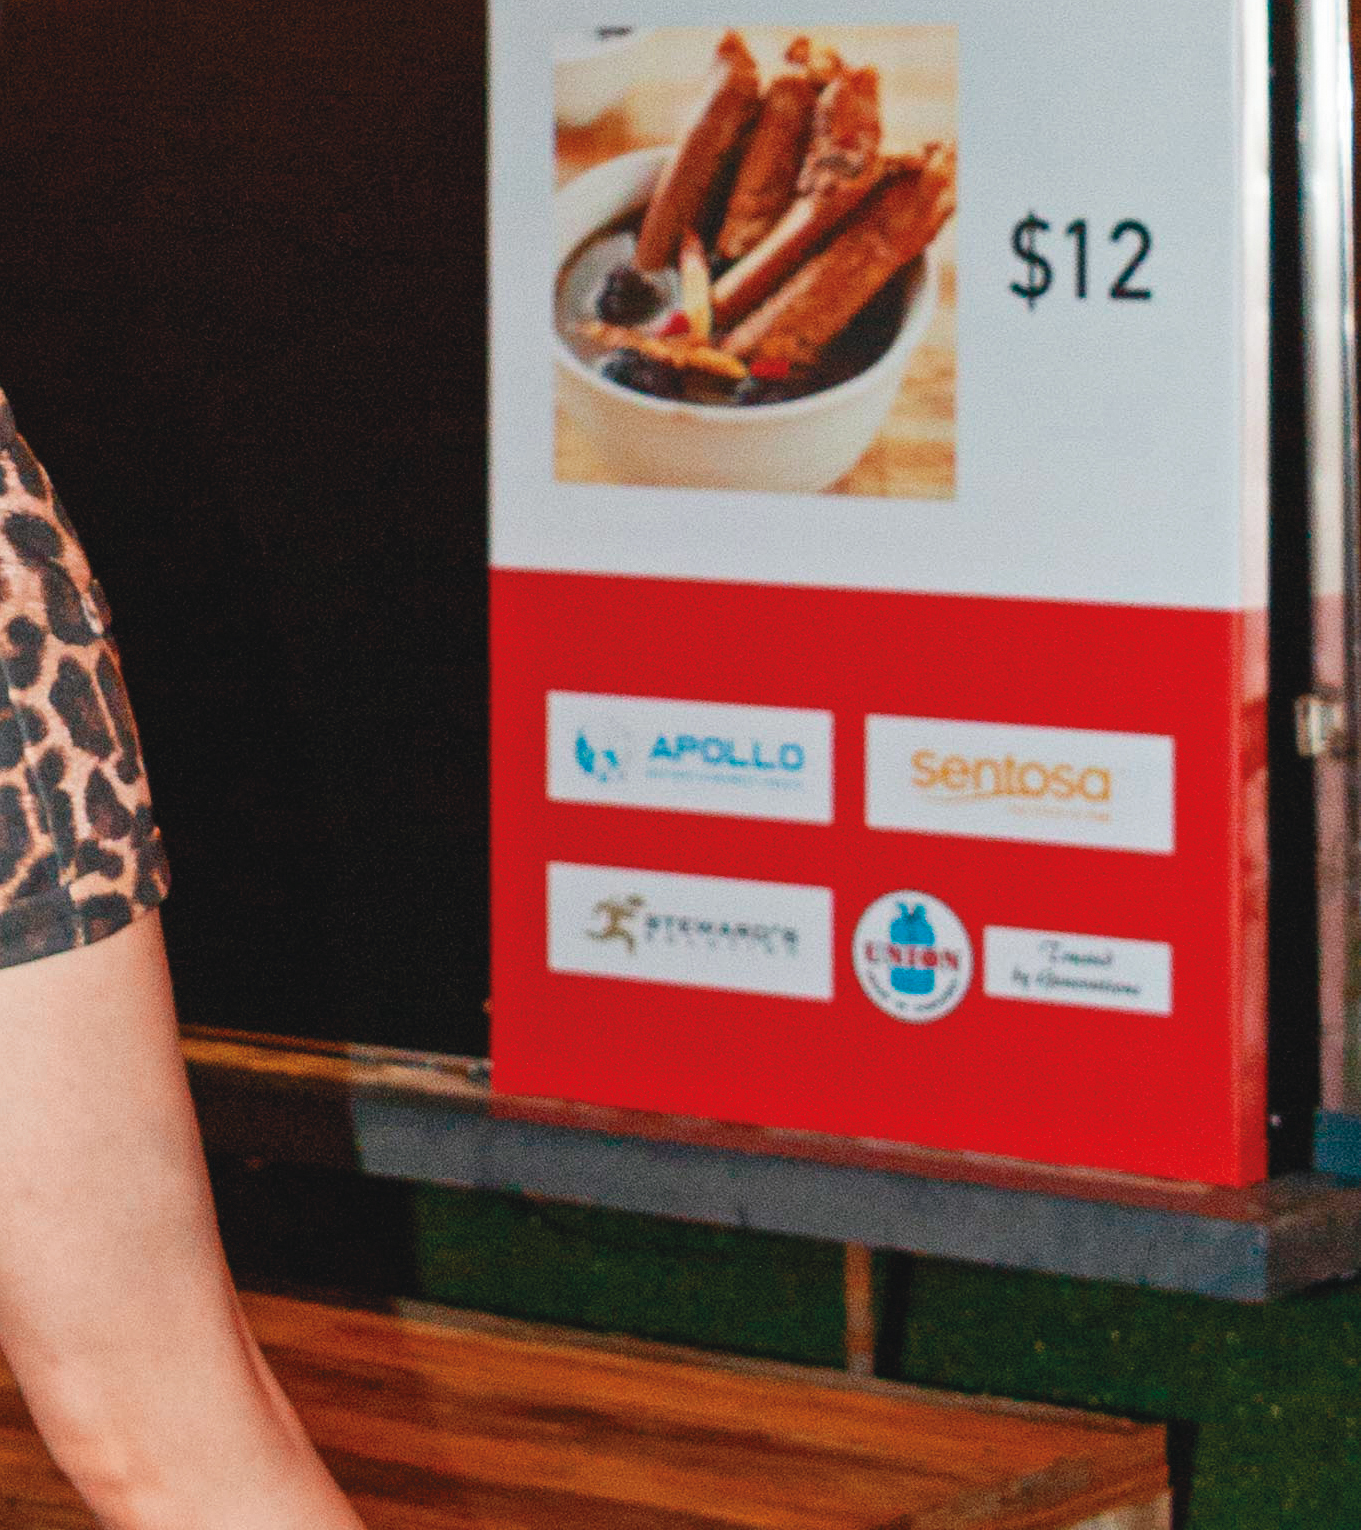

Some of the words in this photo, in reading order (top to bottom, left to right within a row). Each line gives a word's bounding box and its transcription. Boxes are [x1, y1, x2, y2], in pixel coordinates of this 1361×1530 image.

[1008, 210, 1154, 311] $12
[647, 732, 806, 772] APOLLO
[863, 938, 960, 971] UNION
